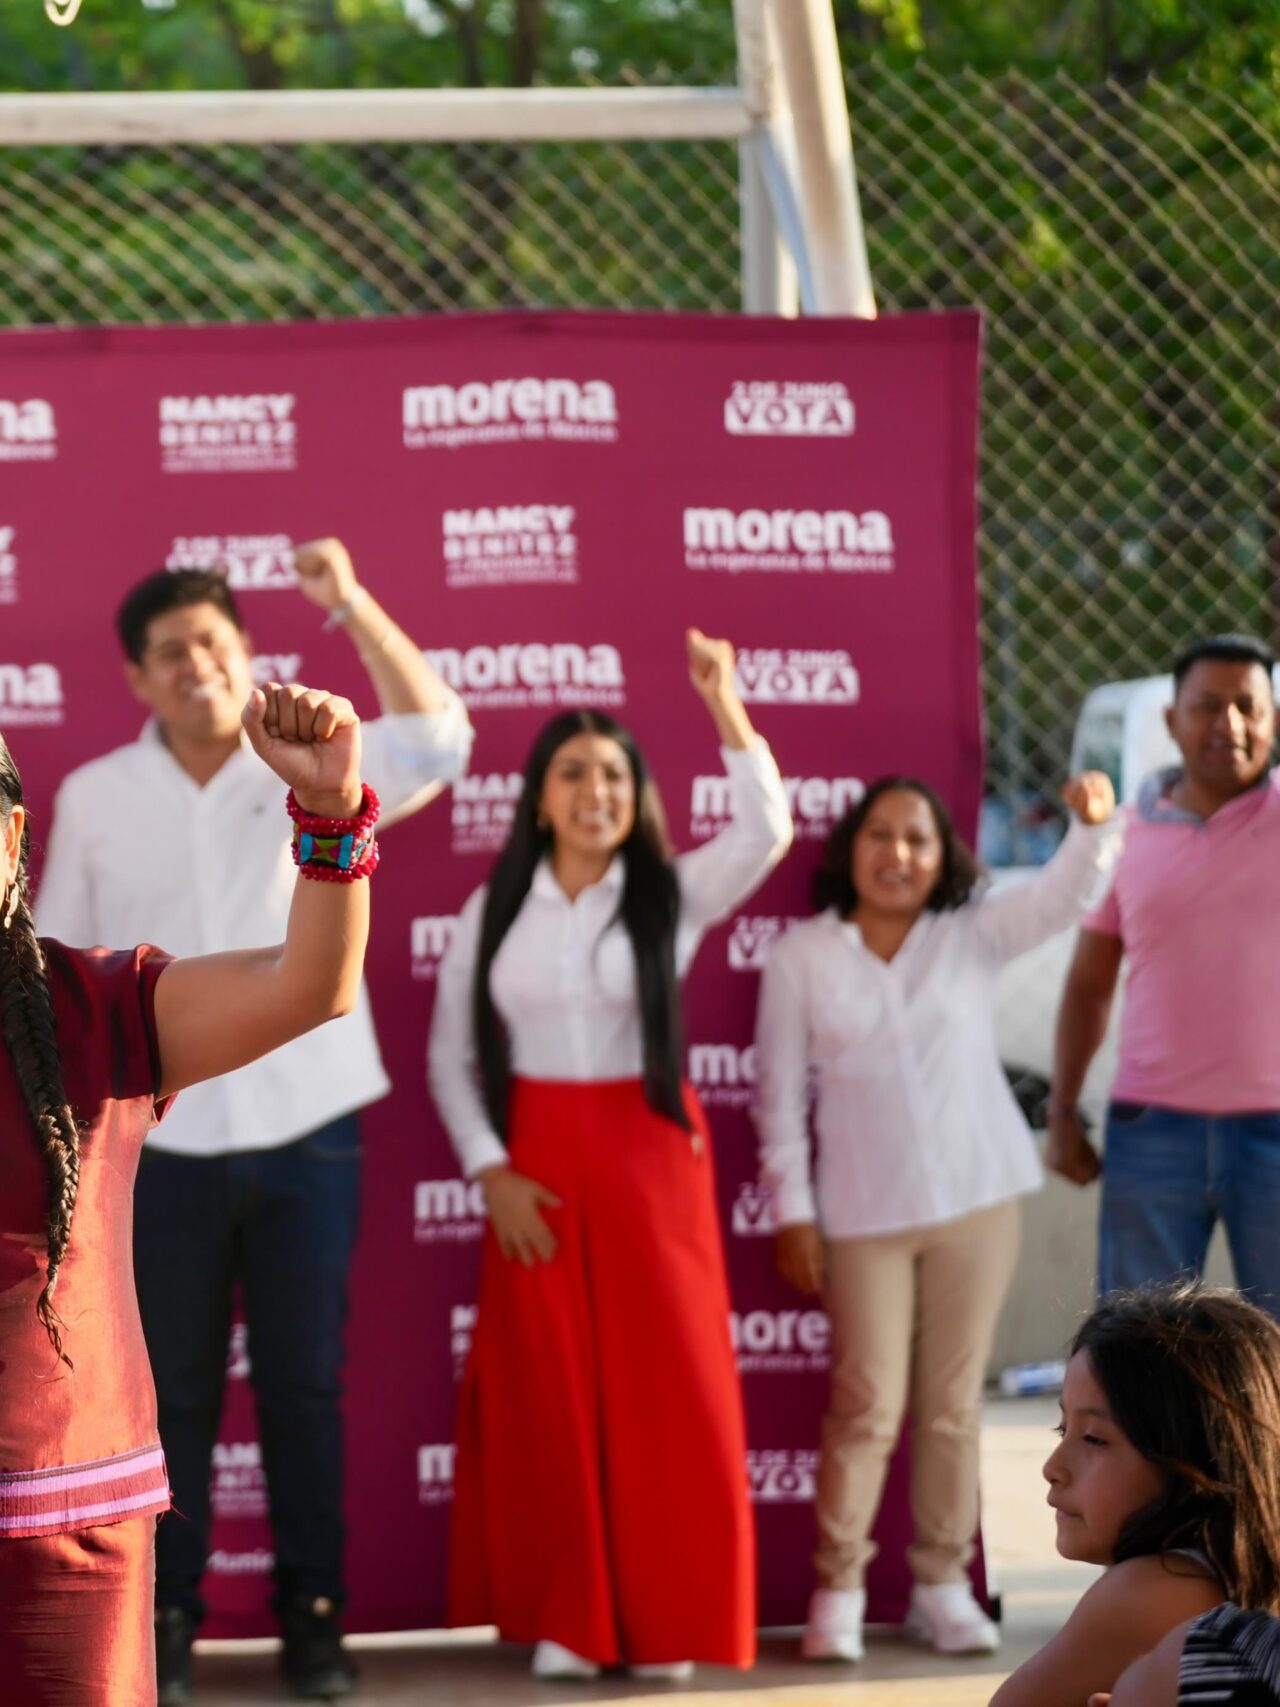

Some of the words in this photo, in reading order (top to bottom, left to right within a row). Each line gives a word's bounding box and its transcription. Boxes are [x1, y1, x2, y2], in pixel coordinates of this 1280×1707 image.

[160, 394, 295, 421] NANCY
[403, 378, 619, 428] morena
[728, 399, 850, 430] VOTA
[442, 505, 575, 534] NANCY
[683, 507, 895, 551] morena
[735, 667, 856, 699] VOTA
